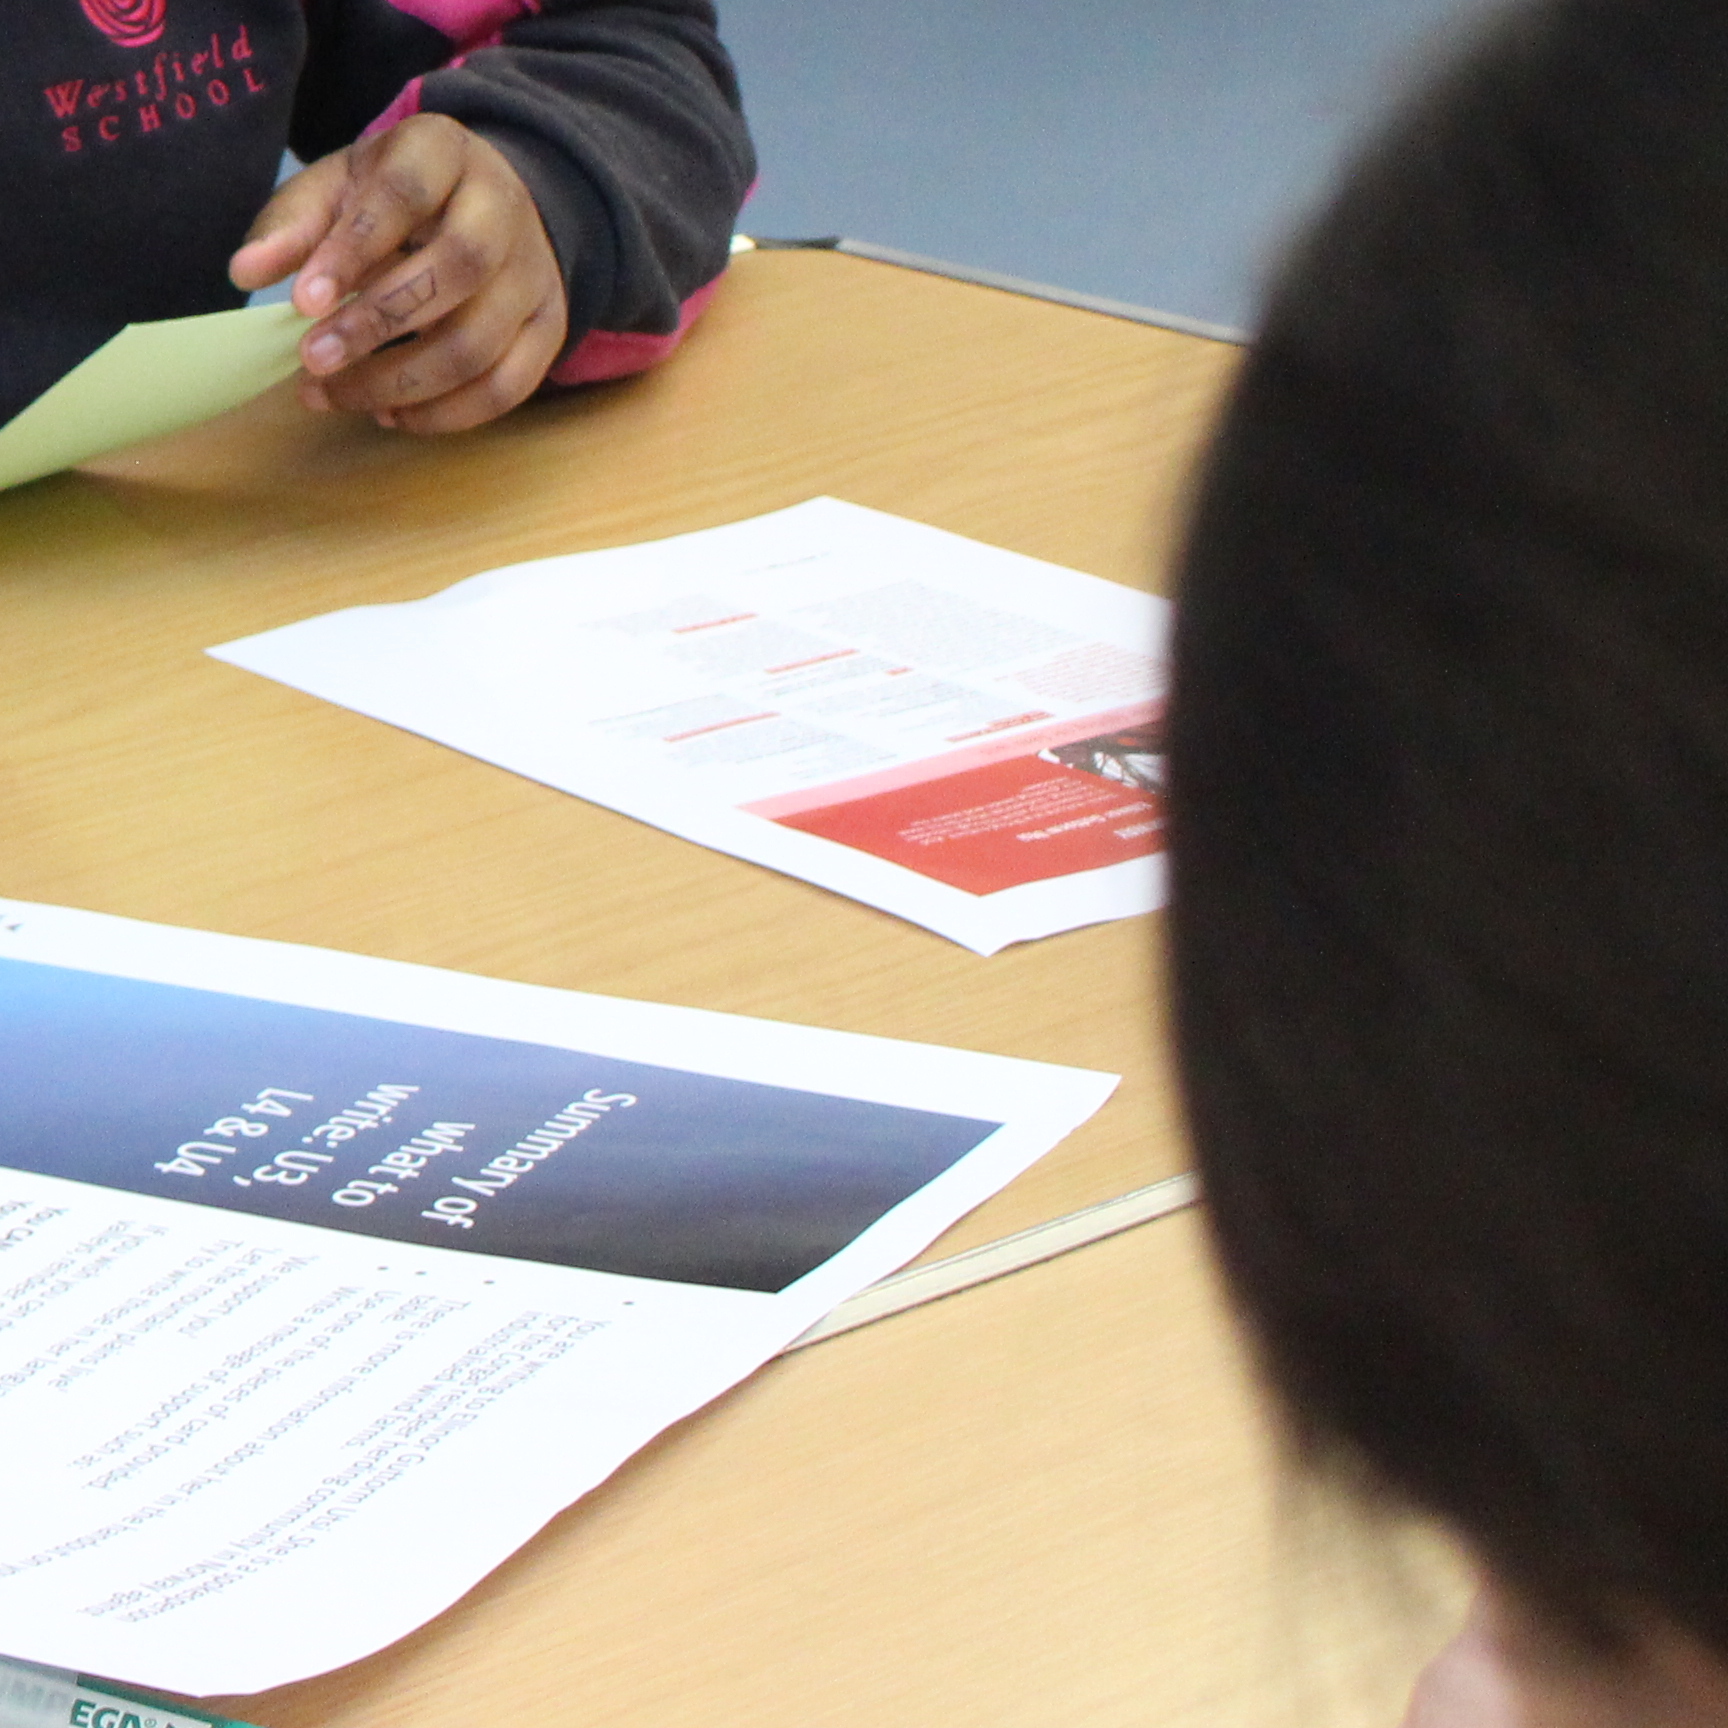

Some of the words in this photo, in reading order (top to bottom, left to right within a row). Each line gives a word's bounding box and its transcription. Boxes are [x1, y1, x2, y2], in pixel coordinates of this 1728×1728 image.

[44, 24, 254, 118] Westfield
[61, 69, 266, 153] SCHOOL
[241, 1087, 314, 1117] L4
[302, 1084, 420, 1148] write:
[204, 1116, 268, 1137] &
[452, 1087, 638, 1196] Summary
[154, 1141, 237, 1176] U4
[233, 1150, 334, 1187] U3,
[368, 1121, 476, 1179] what
[332, 1180, 399, 1207] to
[421, 1196, 477, 1229] of
